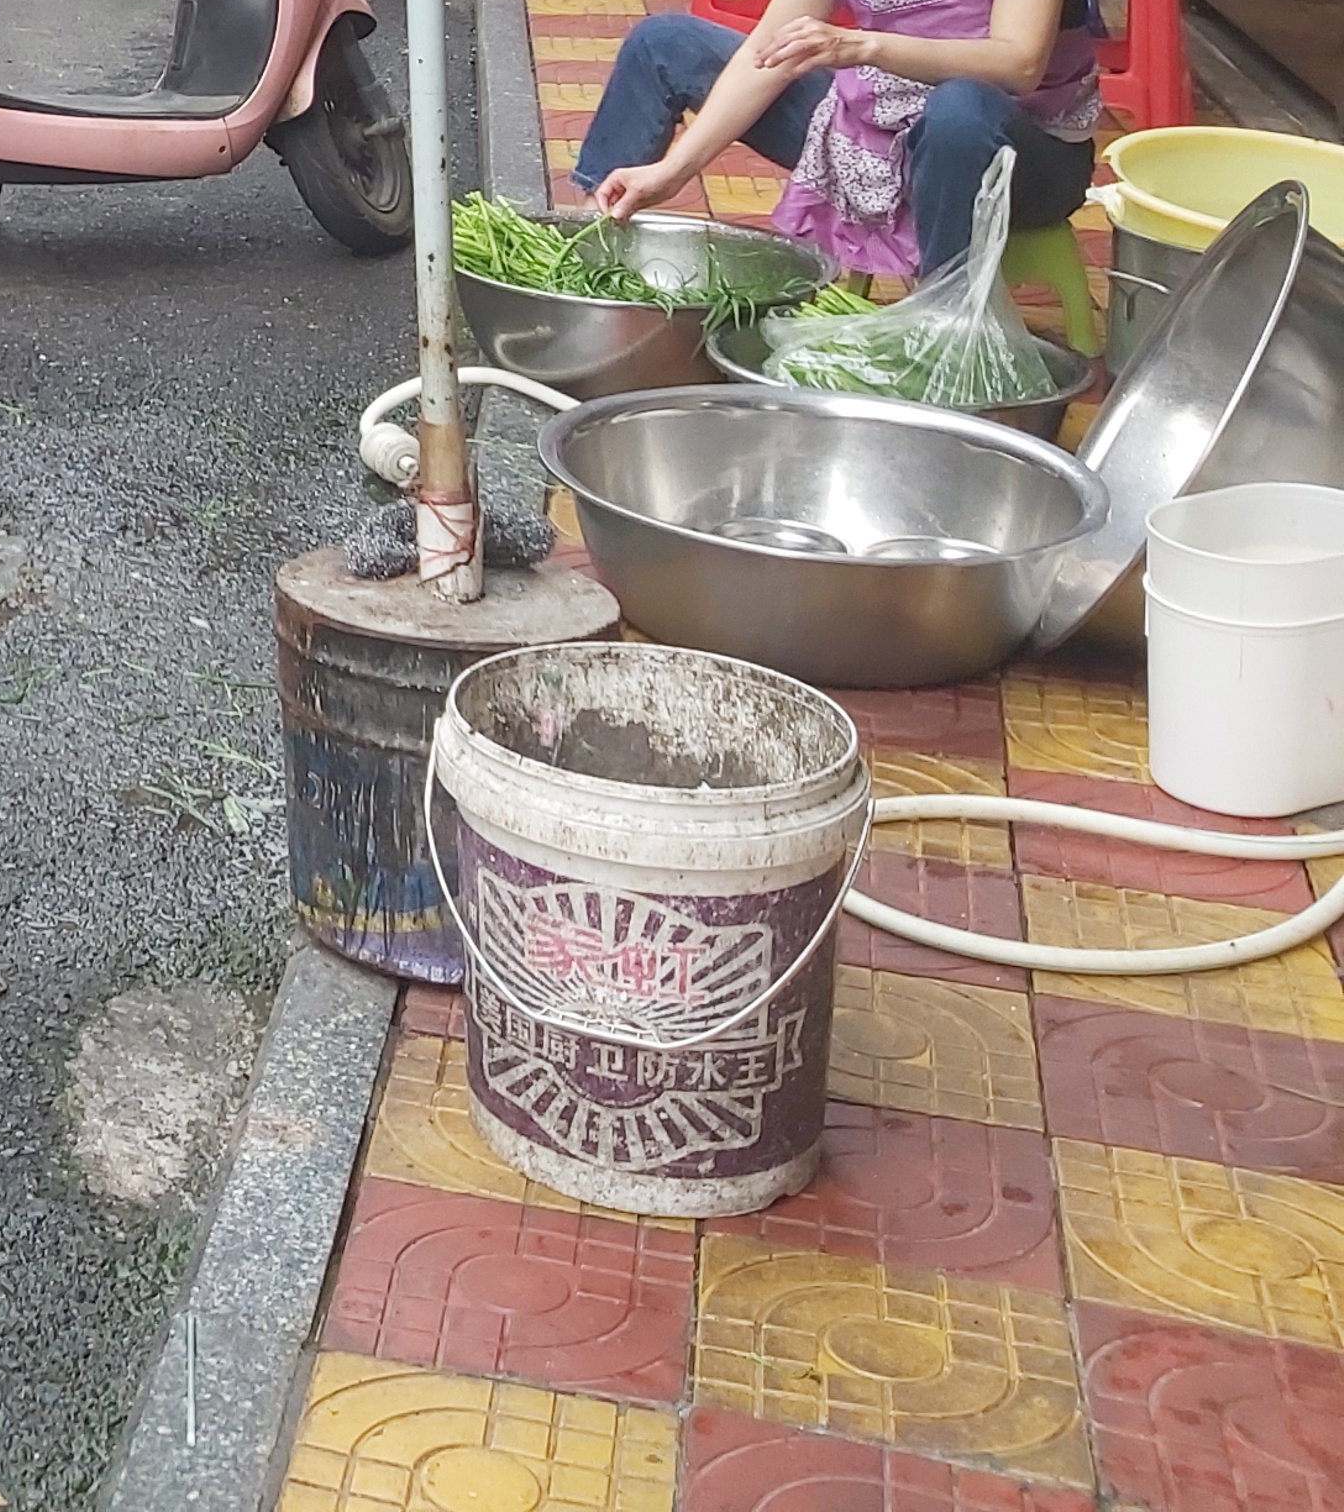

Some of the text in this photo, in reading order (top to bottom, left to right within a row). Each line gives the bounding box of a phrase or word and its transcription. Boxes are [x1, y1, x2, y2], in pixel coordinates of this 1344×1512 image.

[476, 988, 774, 1092] 美国厨卫防水王
